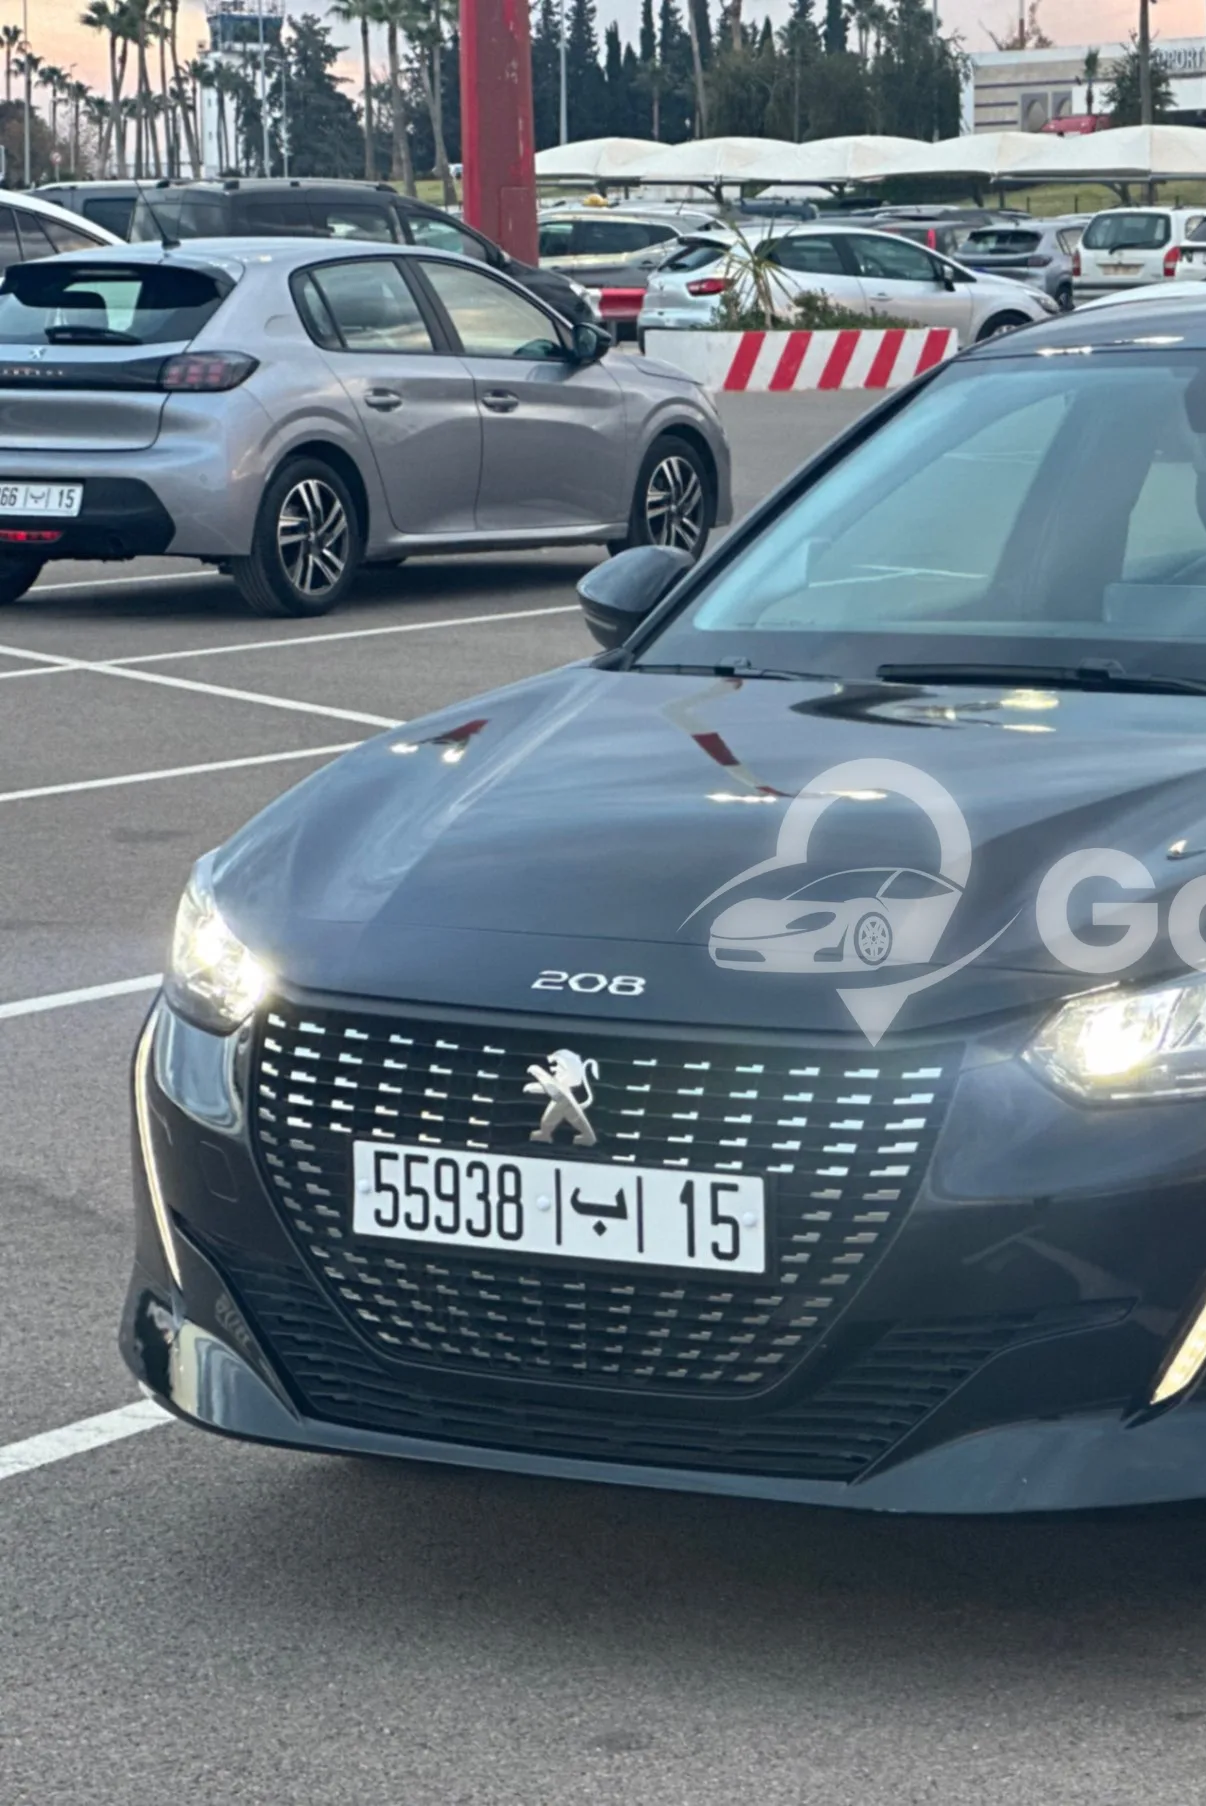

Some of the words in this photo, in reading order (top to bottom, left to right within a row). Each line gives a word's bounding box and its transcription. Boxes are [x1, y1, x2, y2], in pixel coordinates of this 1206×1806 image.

[0, 487, 18, 507] 66
[58, 488, 76, 509] 15
[531, 970, 647, 996] 208
[374, 1150, 524, 1241] 55938
[679, 1180, 741, 1261] 15
